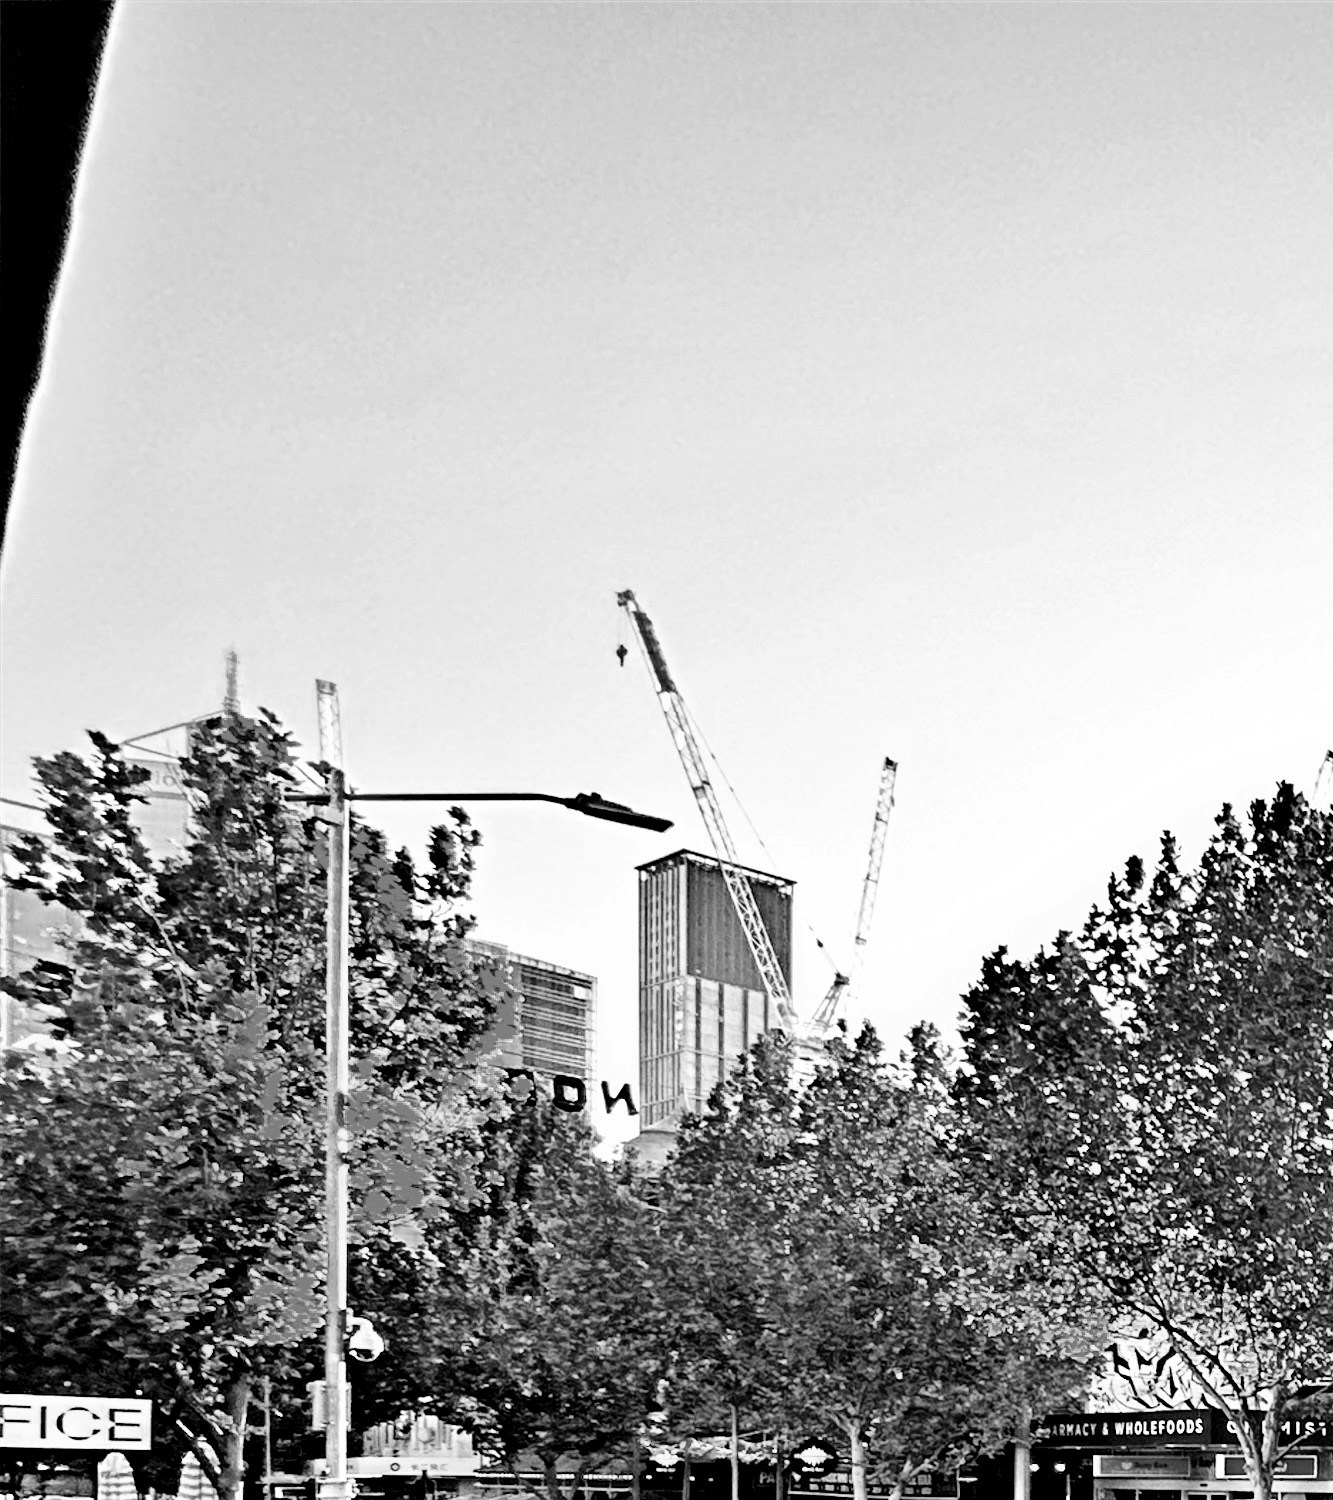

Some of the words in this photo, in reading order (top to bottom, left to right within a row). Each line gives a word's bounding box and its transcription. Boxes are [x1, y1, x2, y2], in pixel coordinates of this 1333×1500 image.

[0, 1404, 142, 1441] FICE
[1040, 1423, 1097, 1437] ARMACY
[1102, 1422, 1109, 1436] &
[1115, 1418, 1203, 1436] WHOLEFOODS
